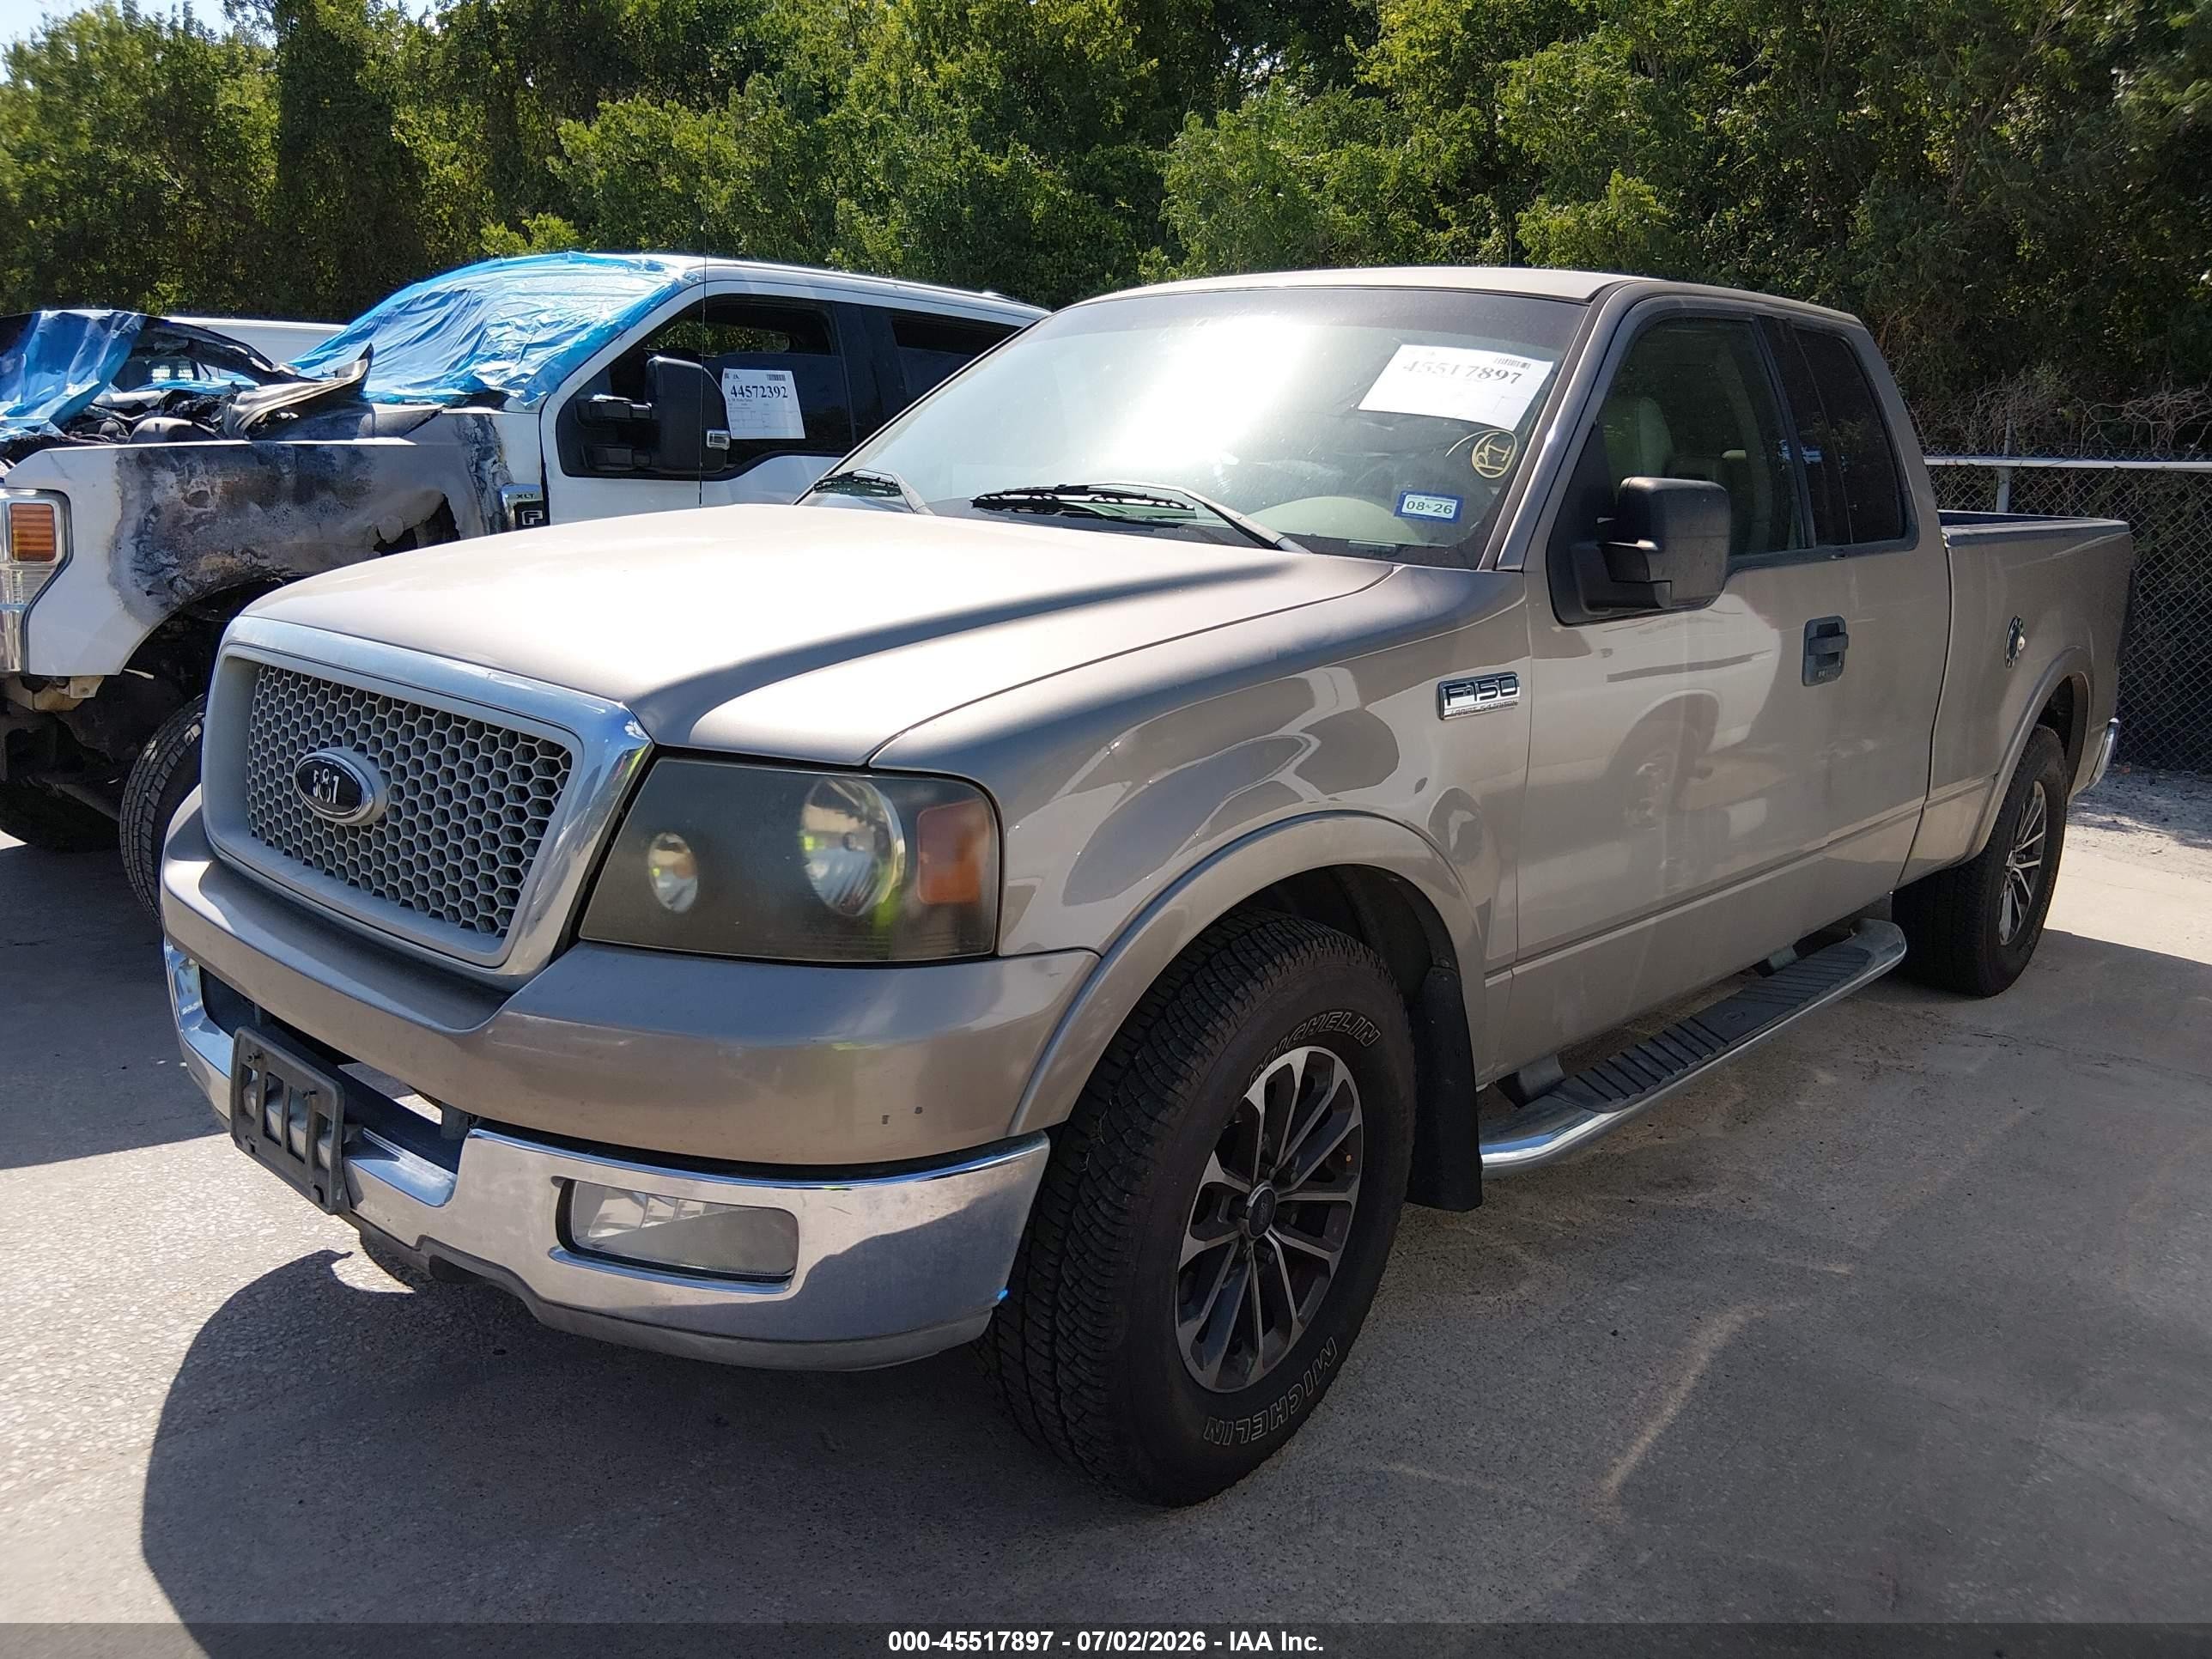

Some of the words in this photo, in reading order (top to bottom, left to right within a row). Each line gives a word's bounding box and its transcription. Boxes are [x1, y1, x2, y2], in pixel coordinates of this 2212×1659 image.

[1403, 360, 1522, 385] 45517897
[730, 384, 788, 398] 44572392
[521, 510, 544, 526] F
[1203, 1336, 1338, 1446] MICHELIN
